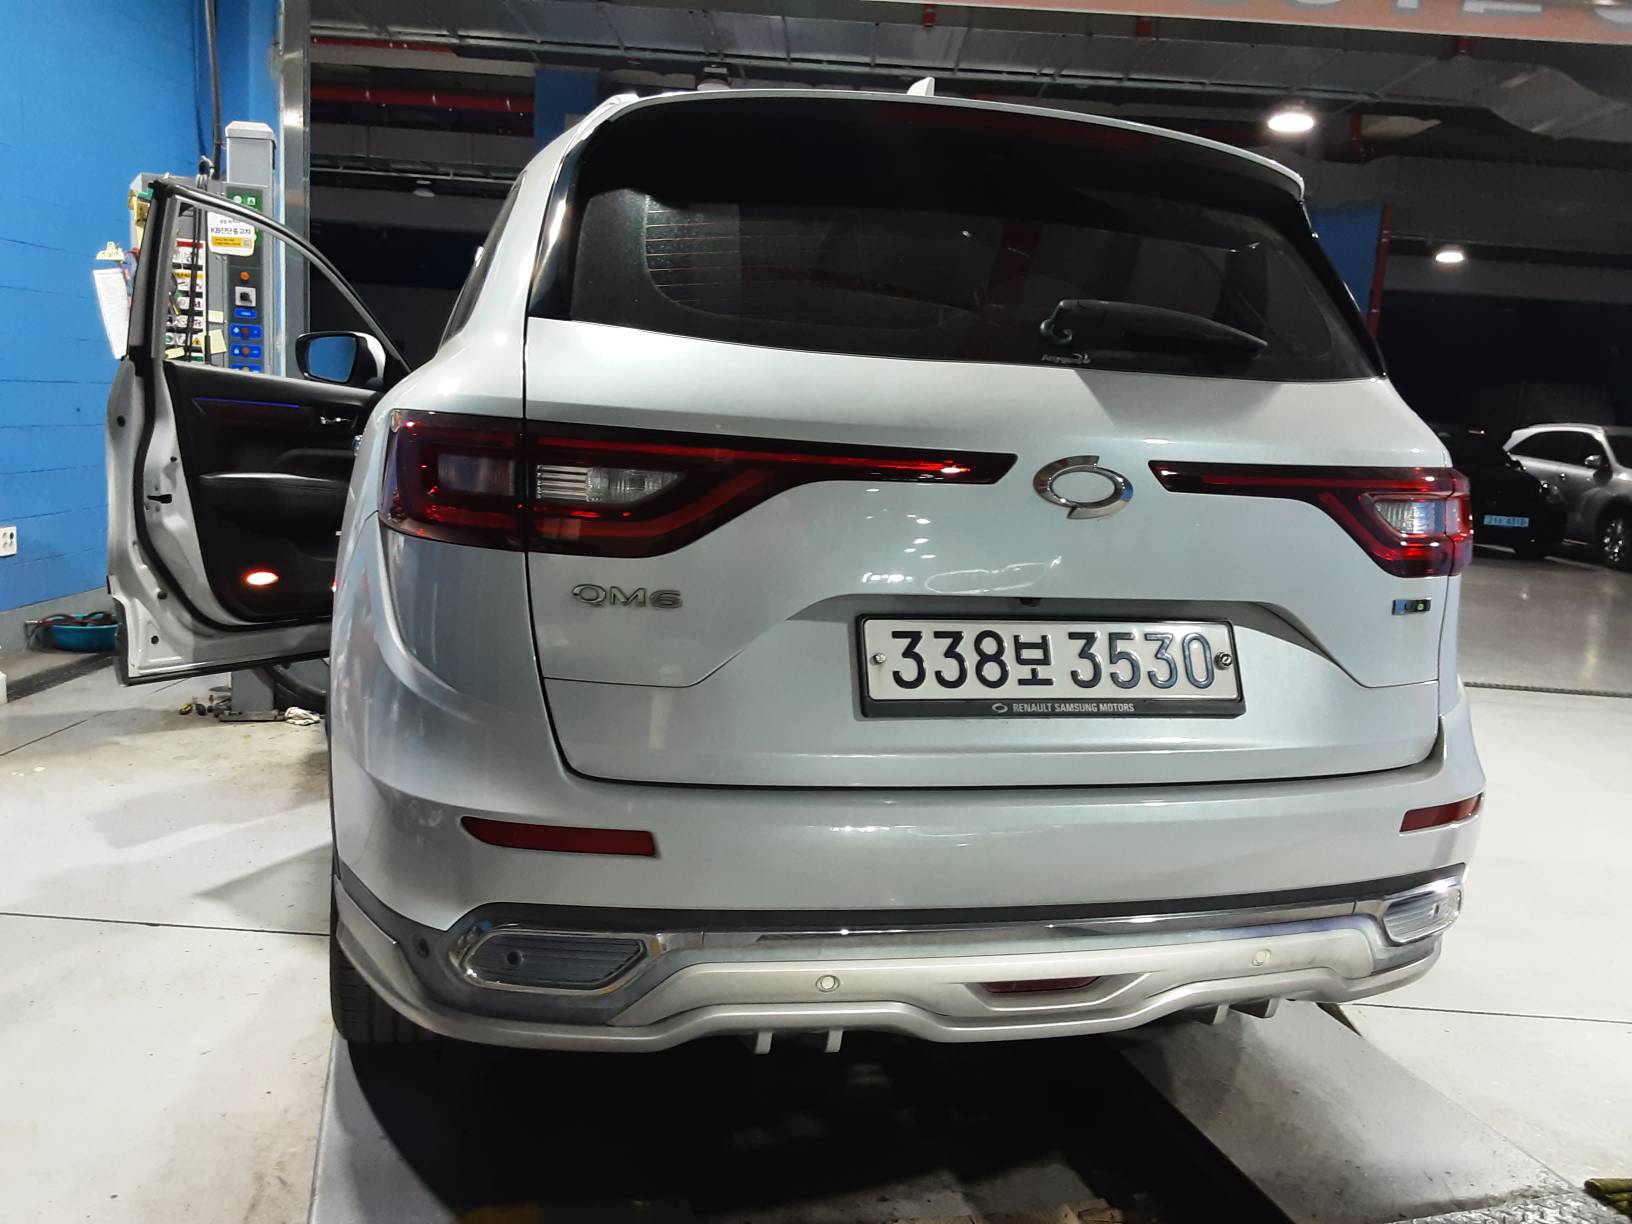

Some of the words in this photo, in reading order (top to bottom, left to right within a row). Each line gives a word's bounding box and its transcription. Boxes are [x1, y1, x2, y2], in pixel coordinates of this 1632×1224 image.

[571, 583, 683, 609] QM6
[1012, 702, 1052, 713] RENAULT
[1054, 702, 1098, 713] SAMSUNG
[1099, 702, 1135, 713] MOTORS
